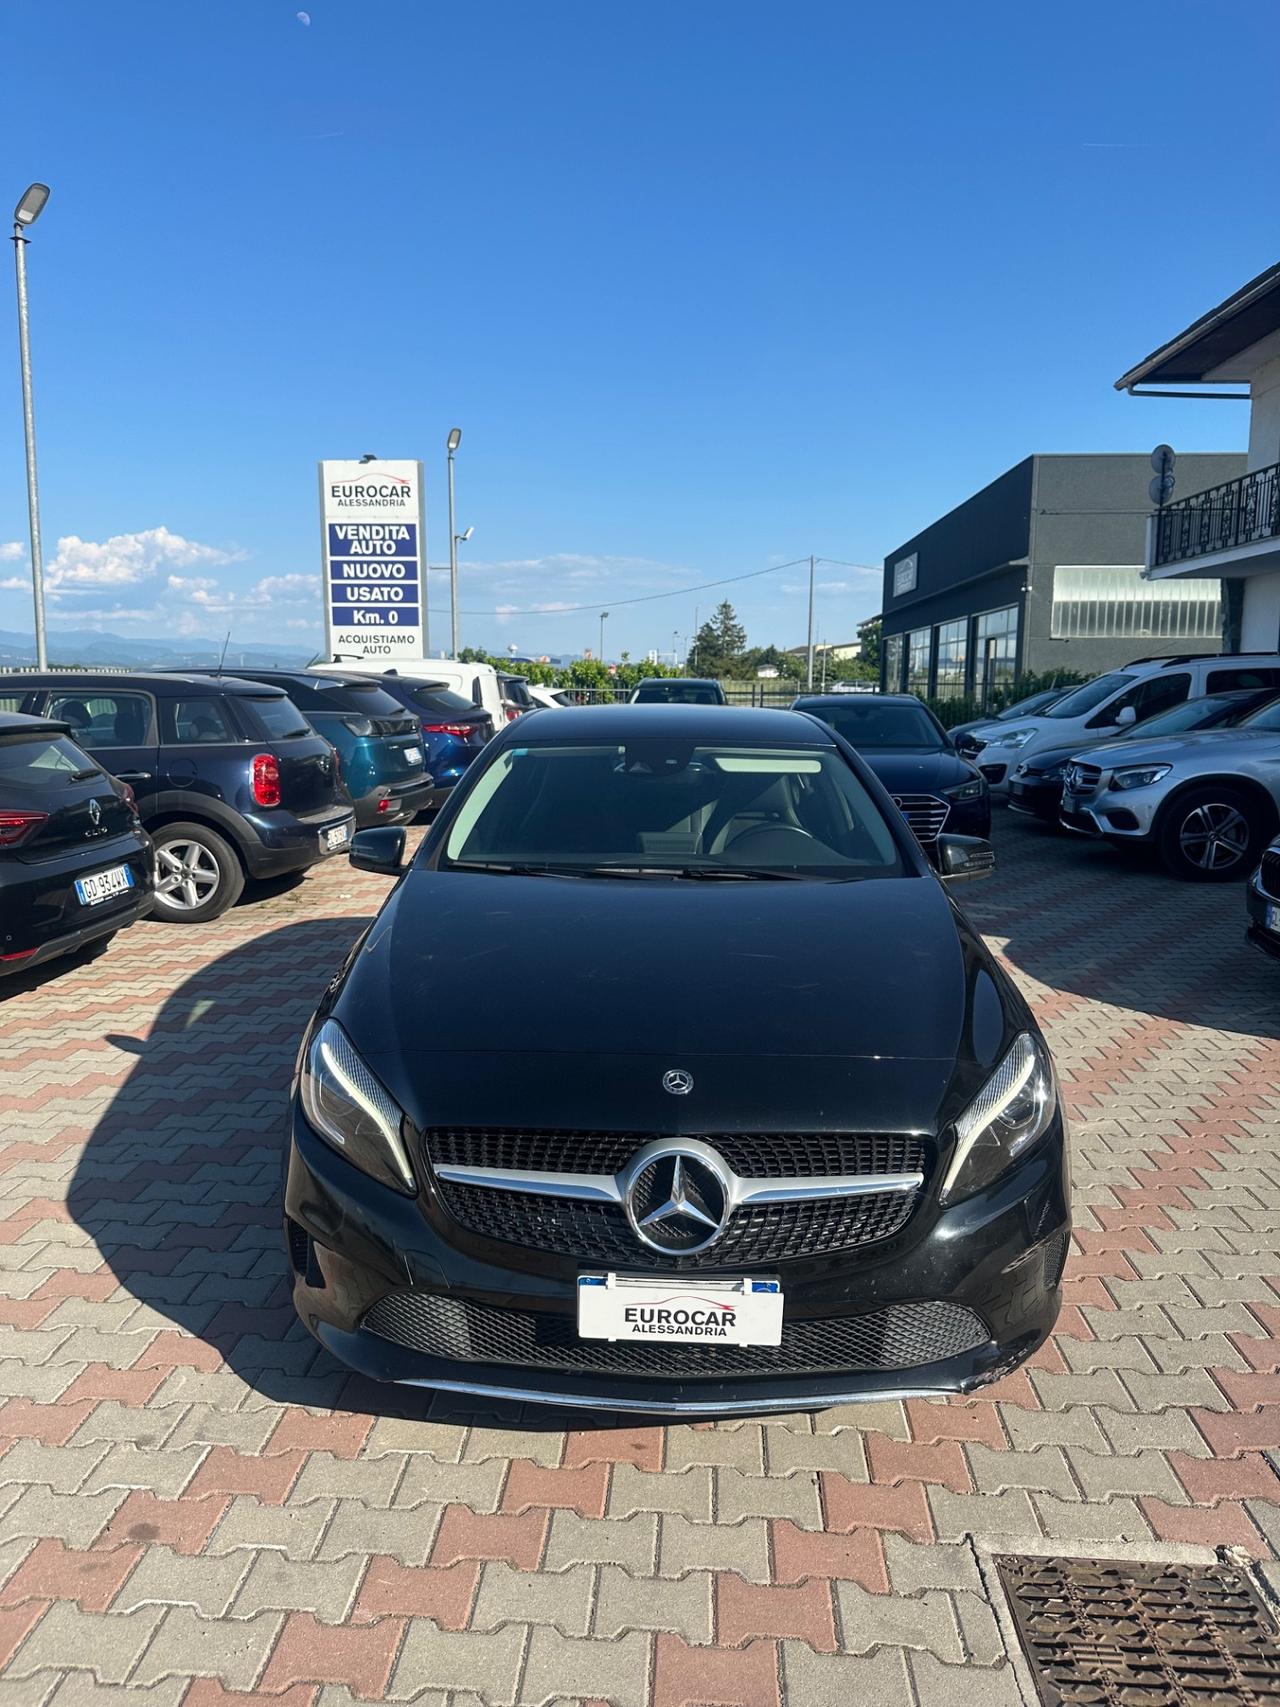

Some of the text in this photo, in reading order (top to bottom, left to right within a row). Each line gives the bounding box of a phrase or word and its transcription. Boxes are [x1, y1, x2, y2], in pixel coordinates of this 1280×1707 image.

[332, 485, 411, 498] EUROCAR
[337, 499, 406, 507] ALESSANDRIA
[335, 526, 410, 540] VENDITA
[350, 541, 396, 555] AUTO
[343, 563, 405, 578] NUOVO
[346, 587, 403, 601] USATO
[353, 610, 398, 624] Km. 0
[338, 634, 415, 645] ACQUISTIAMO
[362, 645, 391, 654] AUTO
[83, 879, 97, 898] GD
[624, 1307, 737, 1327] EUROCAR
[632, 1324, 727, 1337] ALESSANDRIA
